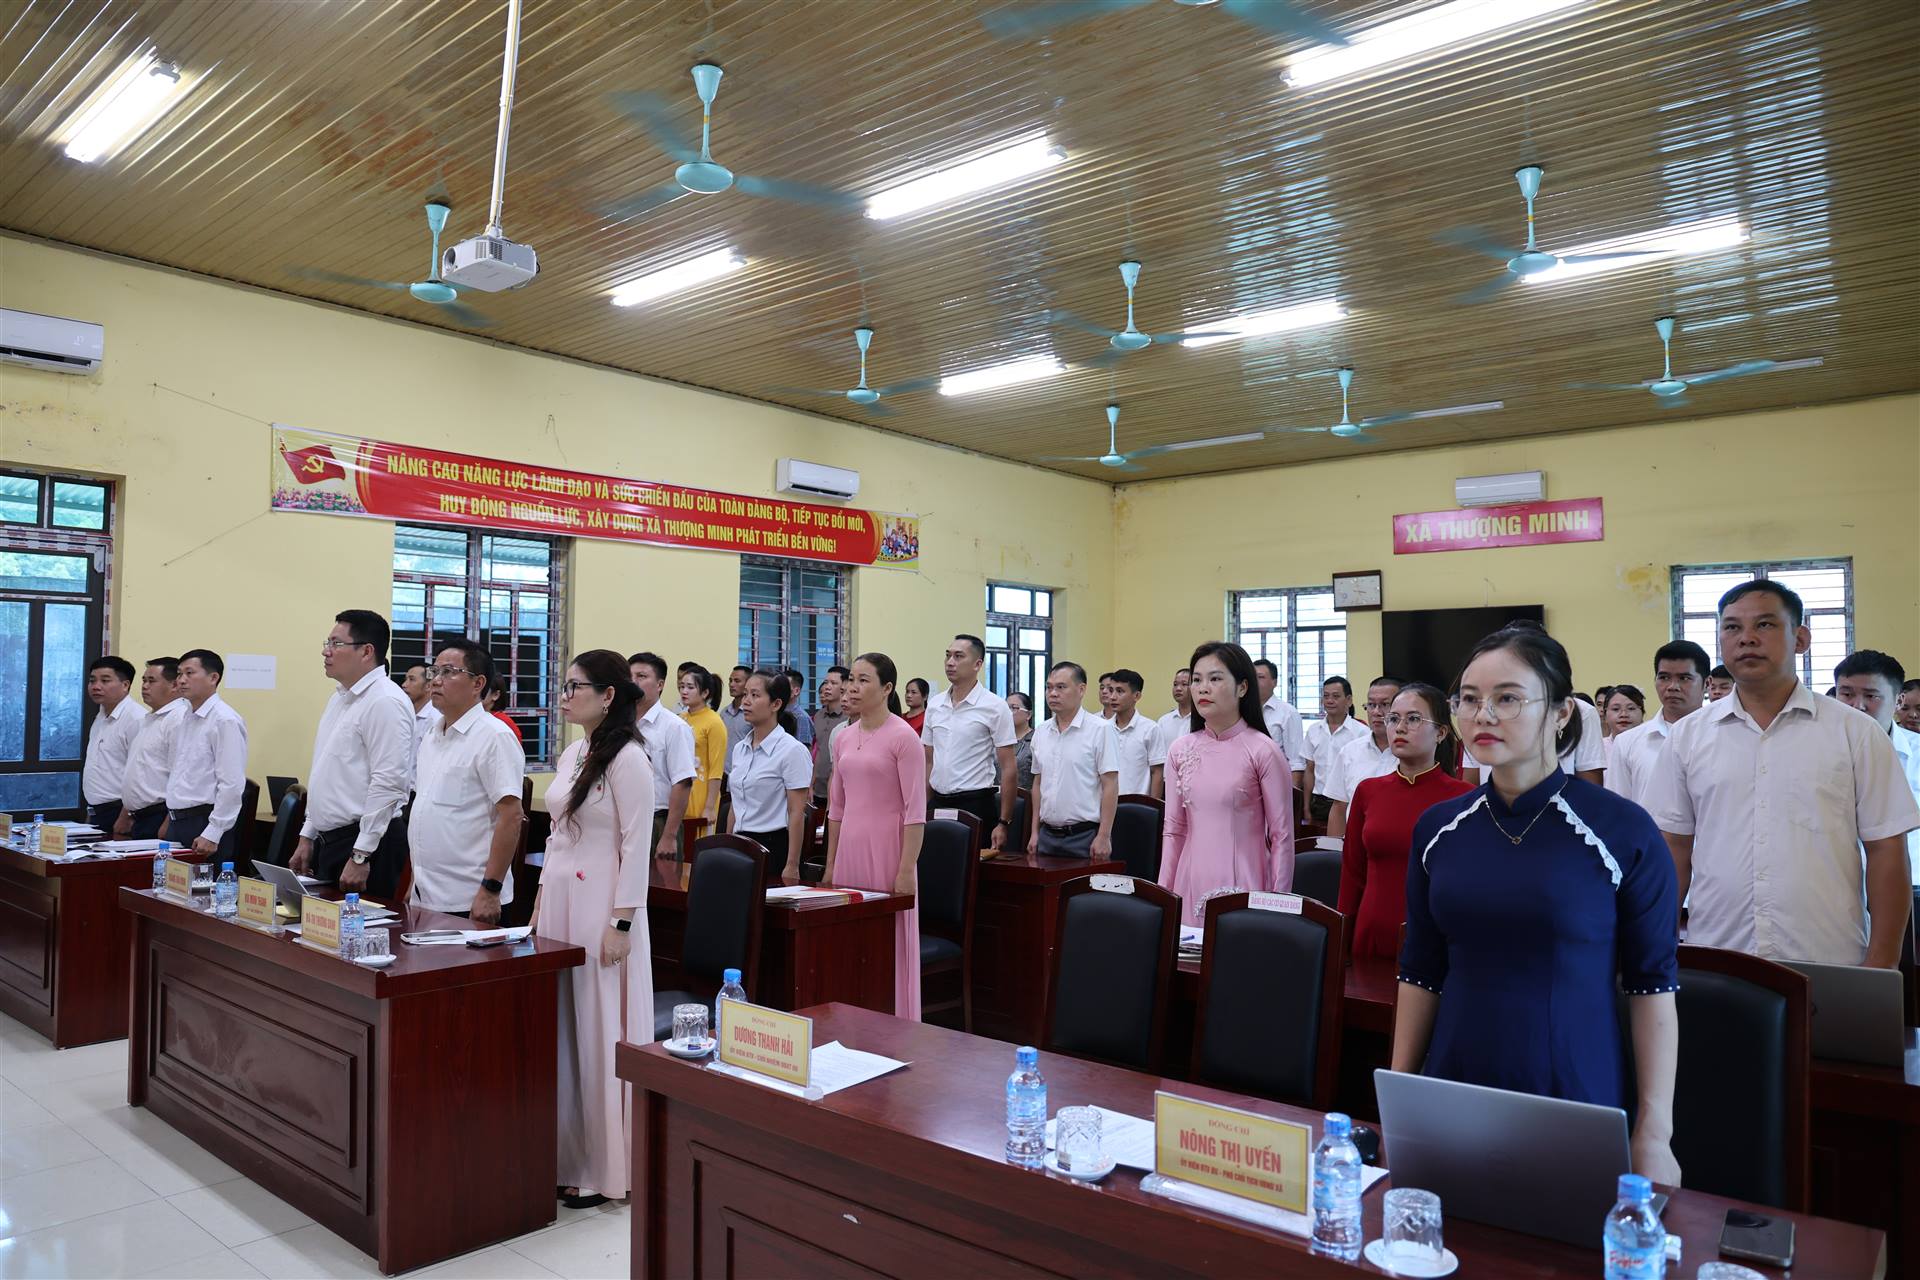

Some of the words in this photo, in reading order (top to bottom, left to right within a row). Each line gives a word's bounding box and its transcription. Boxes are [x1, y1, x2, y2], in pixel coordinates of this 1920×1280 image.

[388, 453, 428, 477] NÂNG
[432, 461, 459, 480] CAO
[463, 463, 500, 486] NĂNG
[505, 470, 528, 491] LỰC
[532, 472, 564, 494] LÃNH
[567, 479, 591, 499] ĐẠO
[594, 480, 609, 499] VÀ
[612, 482, 634, 502] SỨC
[638, 485, 670, 507] CHIẾN
[673, 488, 694, 510] ĐẤU
[697, 492, 717, 512] CỦA
[720, 498, 744, 516] TOÀN
[747, 499, 773, 520] ĐẢNG
[775, 504, 790, 525] BỘ,
[792, 506, 811, 525] TIẾP
[813, 512, 829, 529] TỤC
[831, 510, 845, 529] ĐỔI
[847, 515, 866, 533] MỚI,
[440, 494, 467, 513] HUY
[471, 495, 507, 520] ĐỘNG
[510, 500, 554, 523] NGUỒN
[557, 507, 584, 528] LỰC,
[587, 508, 609, 529] XÂY
[613, 514, 643, 534] DỰNG
[646, 515, 661, 534] XÃ
[663, 520, 704, 540] THƯỢNG
[707, 524, 733, 542] MINH
[736, 526, 760, 545] PHÁT
[762, 527, 789, 548] TRIỂN
[811, 535, 837, 553] VỮNG!
[1405, 520, 1432, 543] XÃ
[1439, 516, 1522, 542] THƯỢNG
[1528, 510, 1590, 534] MINH
[758, 1031, 779, 1053] THANH
[1180, 1128, 1216, 1157] NÔNG
[1220, 1139, 1240, 1168] THỊ
[1245, 1145, 1281, 1174] UYẾN
